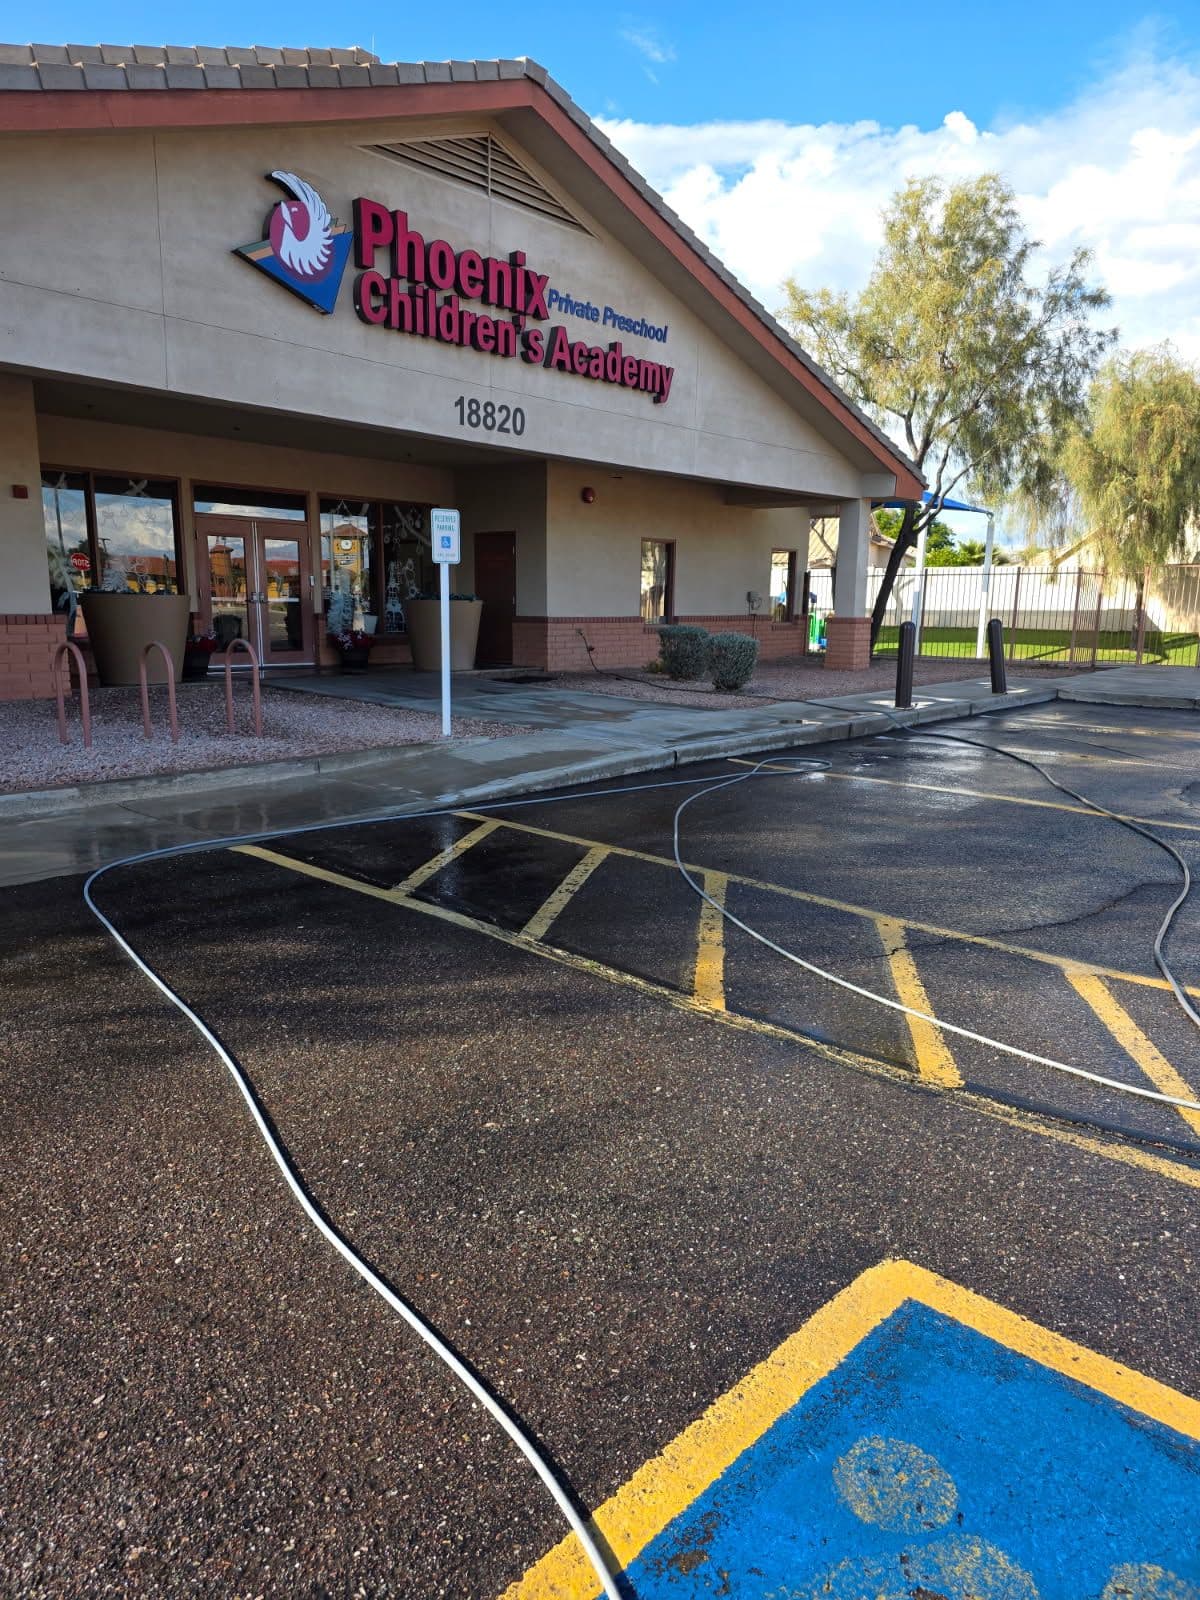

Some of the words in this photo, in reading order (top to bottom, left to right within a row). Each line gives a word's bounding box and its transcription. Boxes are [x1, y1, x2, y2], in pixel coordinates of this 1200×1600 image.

[352, 197, 549, 321] Phoenix
[354, 270, 544, 364] Children's
[544, 326, 674, 403] Academy
[548, 289, 600, 322] Private
[602, 306, 668, 343] Preschool
[454, 396, 526, 436] 18820
